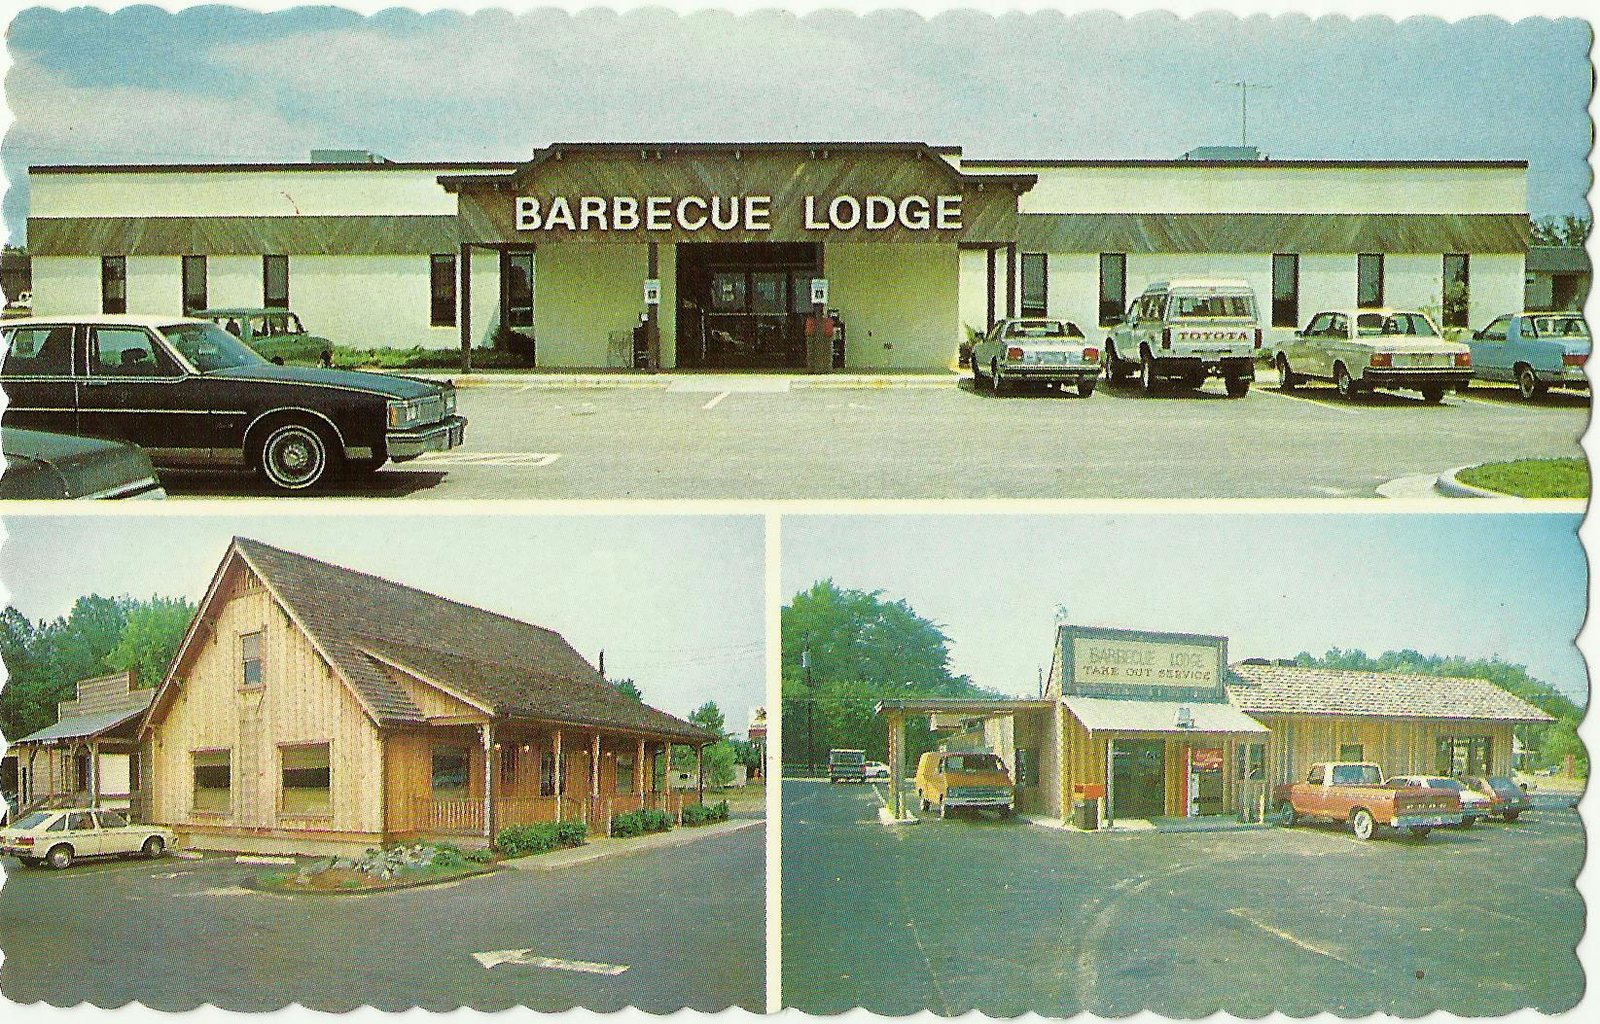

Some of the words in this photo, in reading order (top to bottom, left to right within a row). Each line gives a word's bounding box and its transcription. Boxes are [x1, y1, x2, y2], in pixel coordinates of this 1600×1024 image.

[514, 195, 771, 232] BARBECUE
[805, 194, 964, 232] LODGE
[1178, 330, 1248, 342] TOYOTA
[1089, 647, 1156, 666] BARBECUE
[1083, 665, 1120, 676] TAKE
[1125, 667, 1153, 677] OUT
[1158, 669, 1212, 681] SERVICE
